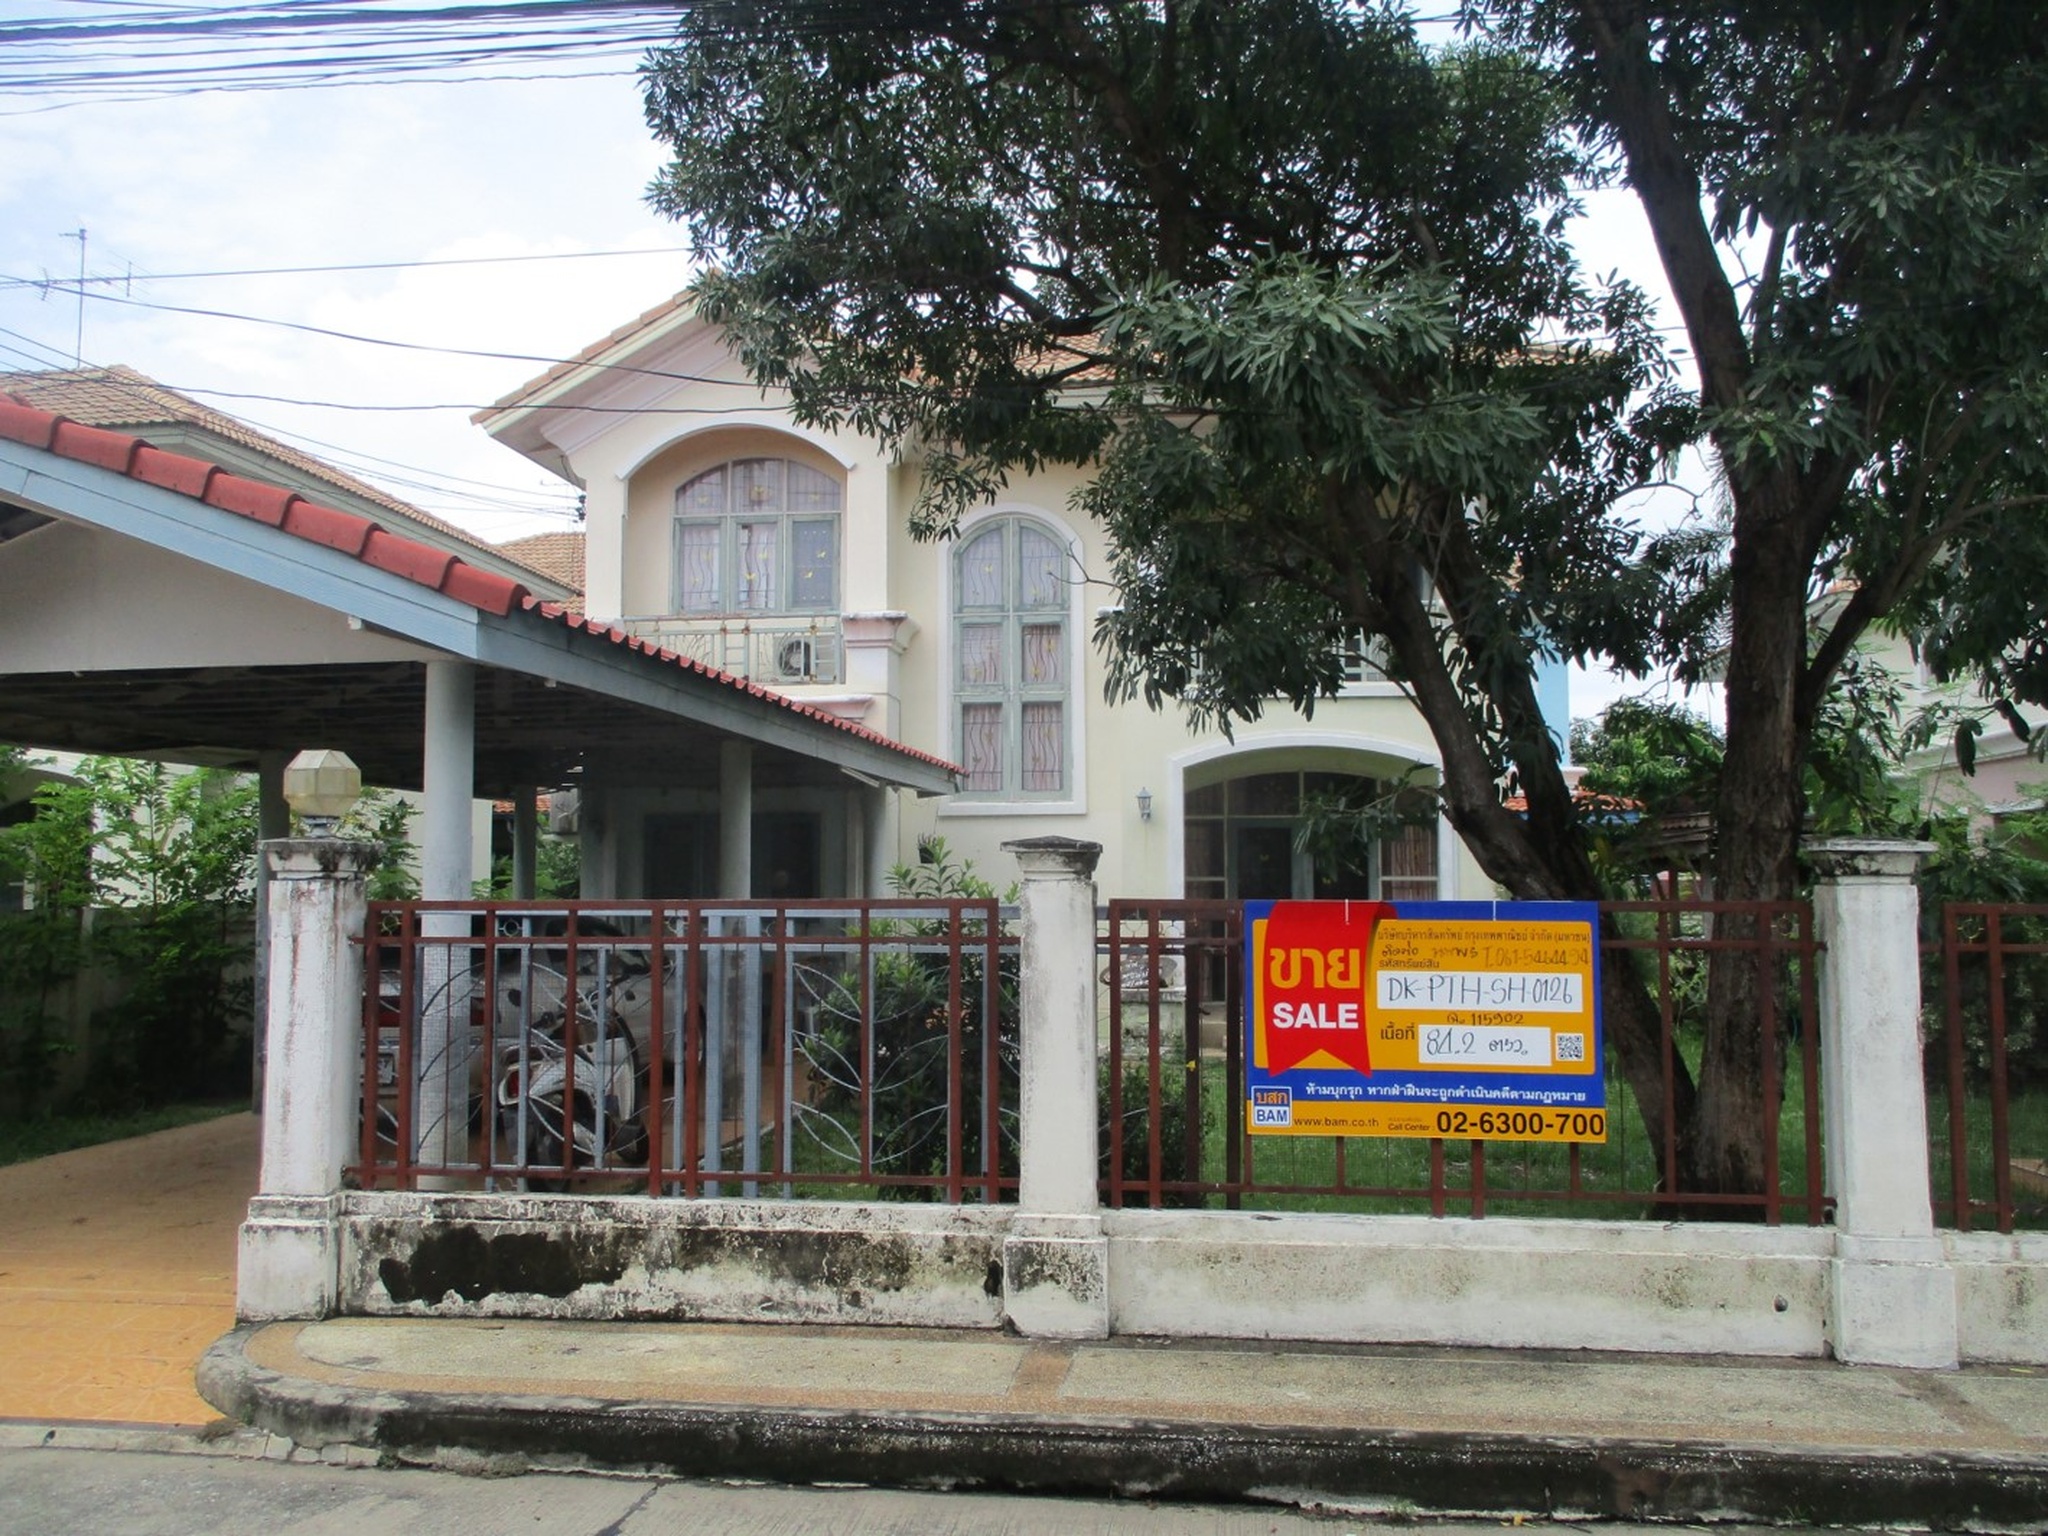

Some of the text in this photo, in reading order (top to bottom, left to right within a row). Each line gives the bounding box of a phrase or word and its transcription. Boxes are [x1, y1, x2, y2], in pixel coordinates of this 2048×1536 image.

[1269, 947, 1361, 990] ขาย
[1379, 957, 1440, 969] รหัสทรัพย์สิน
[1272, 1001, 1360, 1030] SALE
[1380, 1021, 1416, 1041] เนื้อที่
[1255, 1090, 1289, 1105] บสก
[1305, 1082, 1586, 1104] ห้ามบุกรุก หากฝ่าฝืนจะถูกดำเนินคดีตามกฎหมาย
[1256, 1108, 1288, 1123] BAM
[1293, 1116, 1380, 1128] www.bam.co.th
[1387, 1122, 1403, 1131] Call
[1436, 1110, 1605, 1136] 02-6300-700
